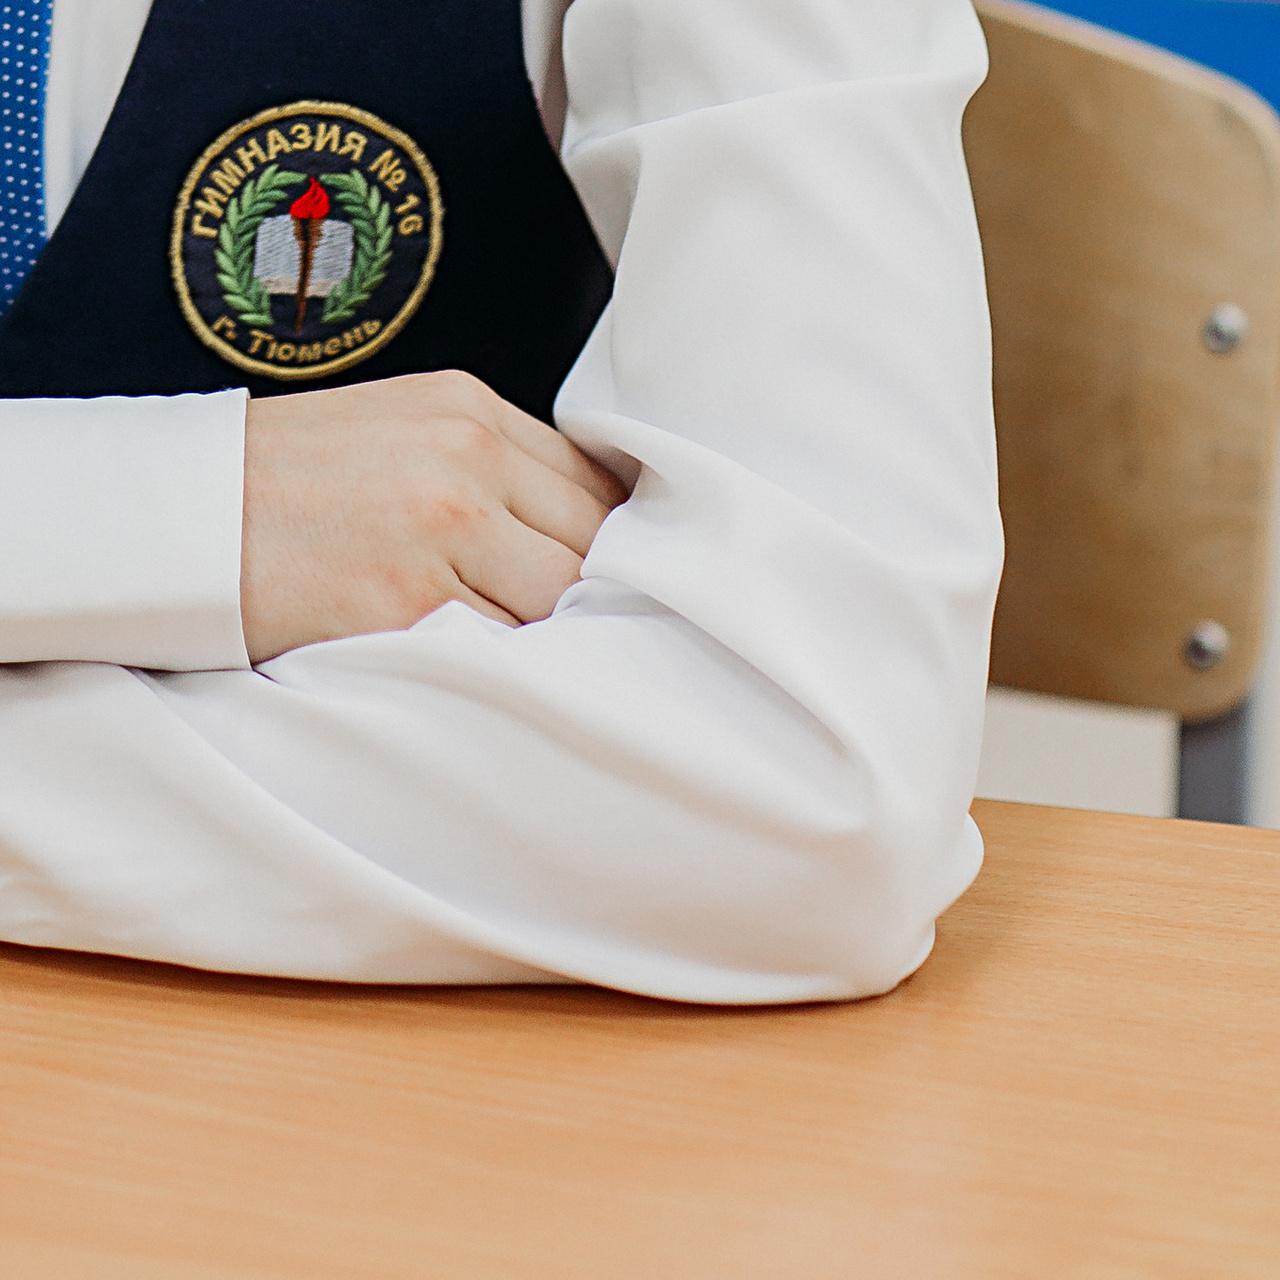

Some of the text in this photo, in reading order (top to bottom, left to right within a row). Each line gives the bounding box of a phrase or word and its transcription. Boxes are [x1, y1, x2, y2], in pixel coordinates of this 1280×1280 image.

[191, 123, 368, 238] ГИМНАЗИЯ
[395, 194, 423, 236] 16
[248, 319, 382, 362] Тюмень
